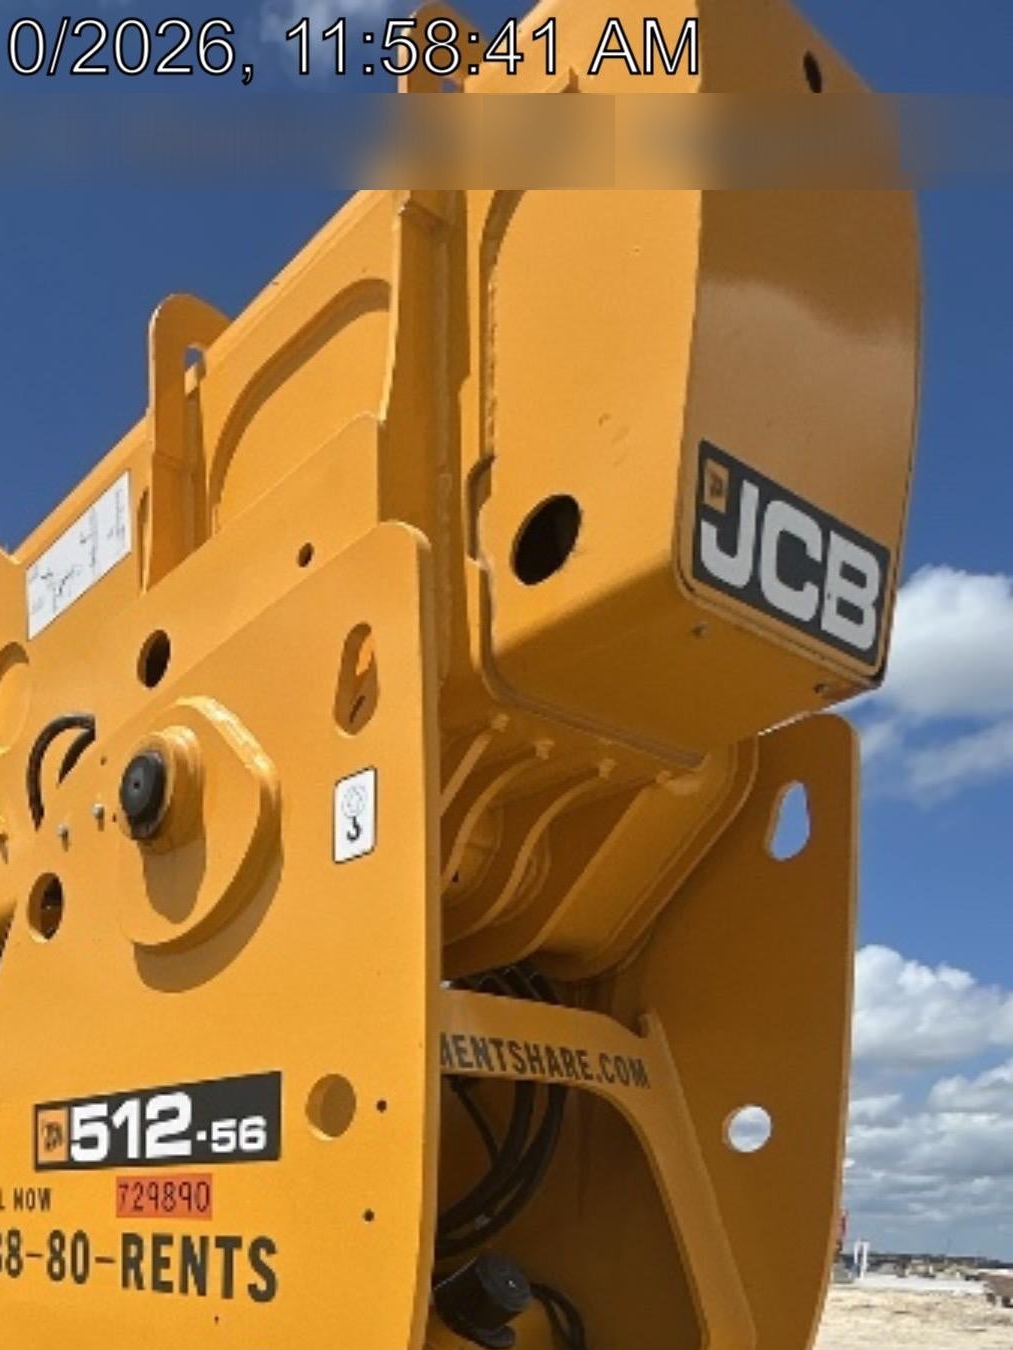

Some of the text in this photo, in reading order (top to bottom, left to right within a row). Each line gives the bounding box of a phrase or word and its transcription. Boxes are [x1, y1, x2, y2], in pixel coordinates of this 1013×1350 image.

[700, 479, 881, 651] JCB
[14, 1188, 52, 1211] NOW
[117, 1180, 210, 1213] 729890
